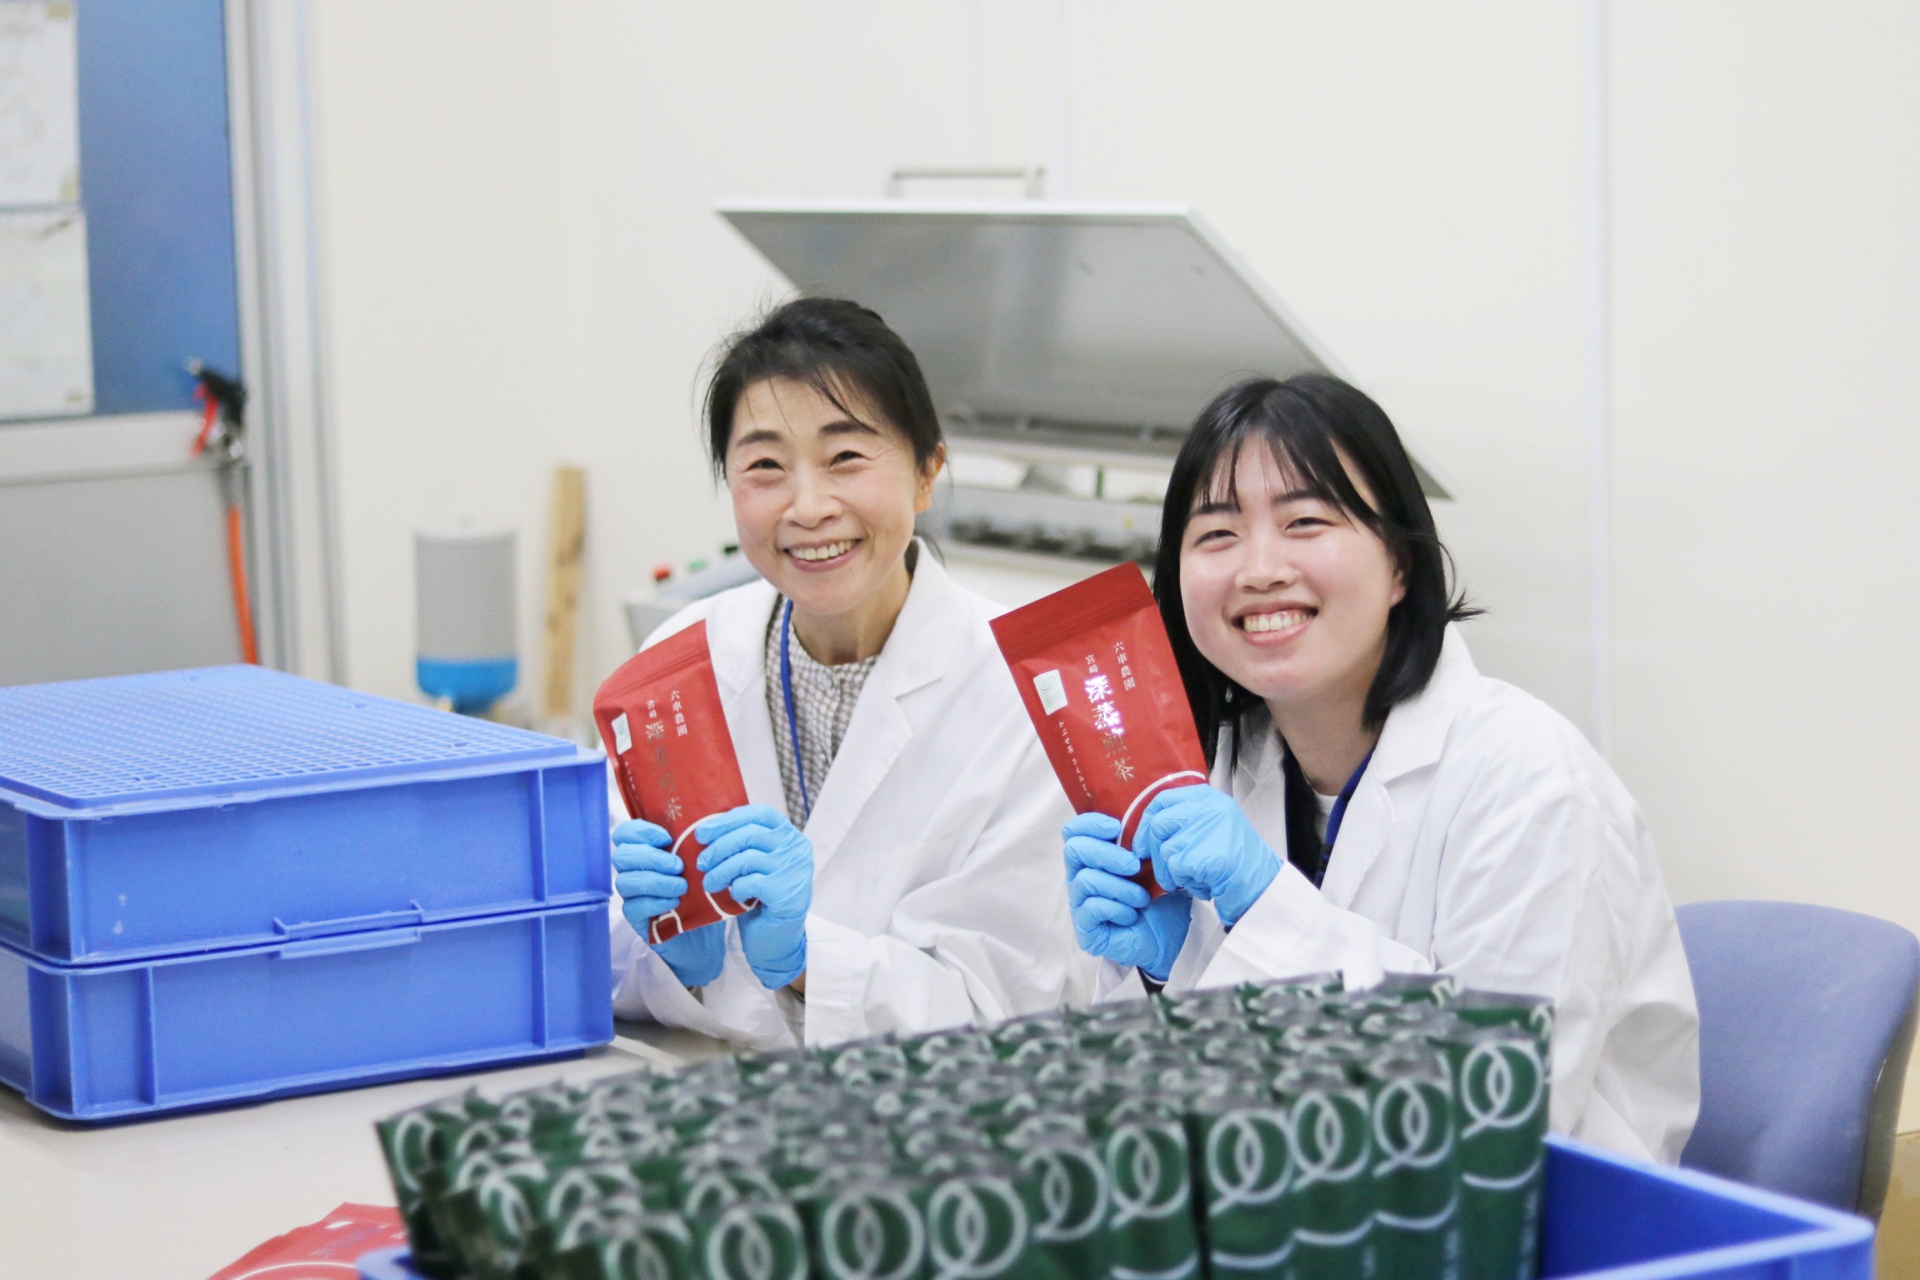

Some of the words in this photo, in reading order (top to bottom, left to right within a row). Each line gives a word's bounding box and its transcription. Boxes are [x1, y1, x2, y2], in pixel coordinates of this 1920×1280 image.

[1085, 654, 1099, 674] 宮崎
[1113, 641, 1136, 691] 六車農園
[1084, 674, 1135, 782] 深蒸煎茶
